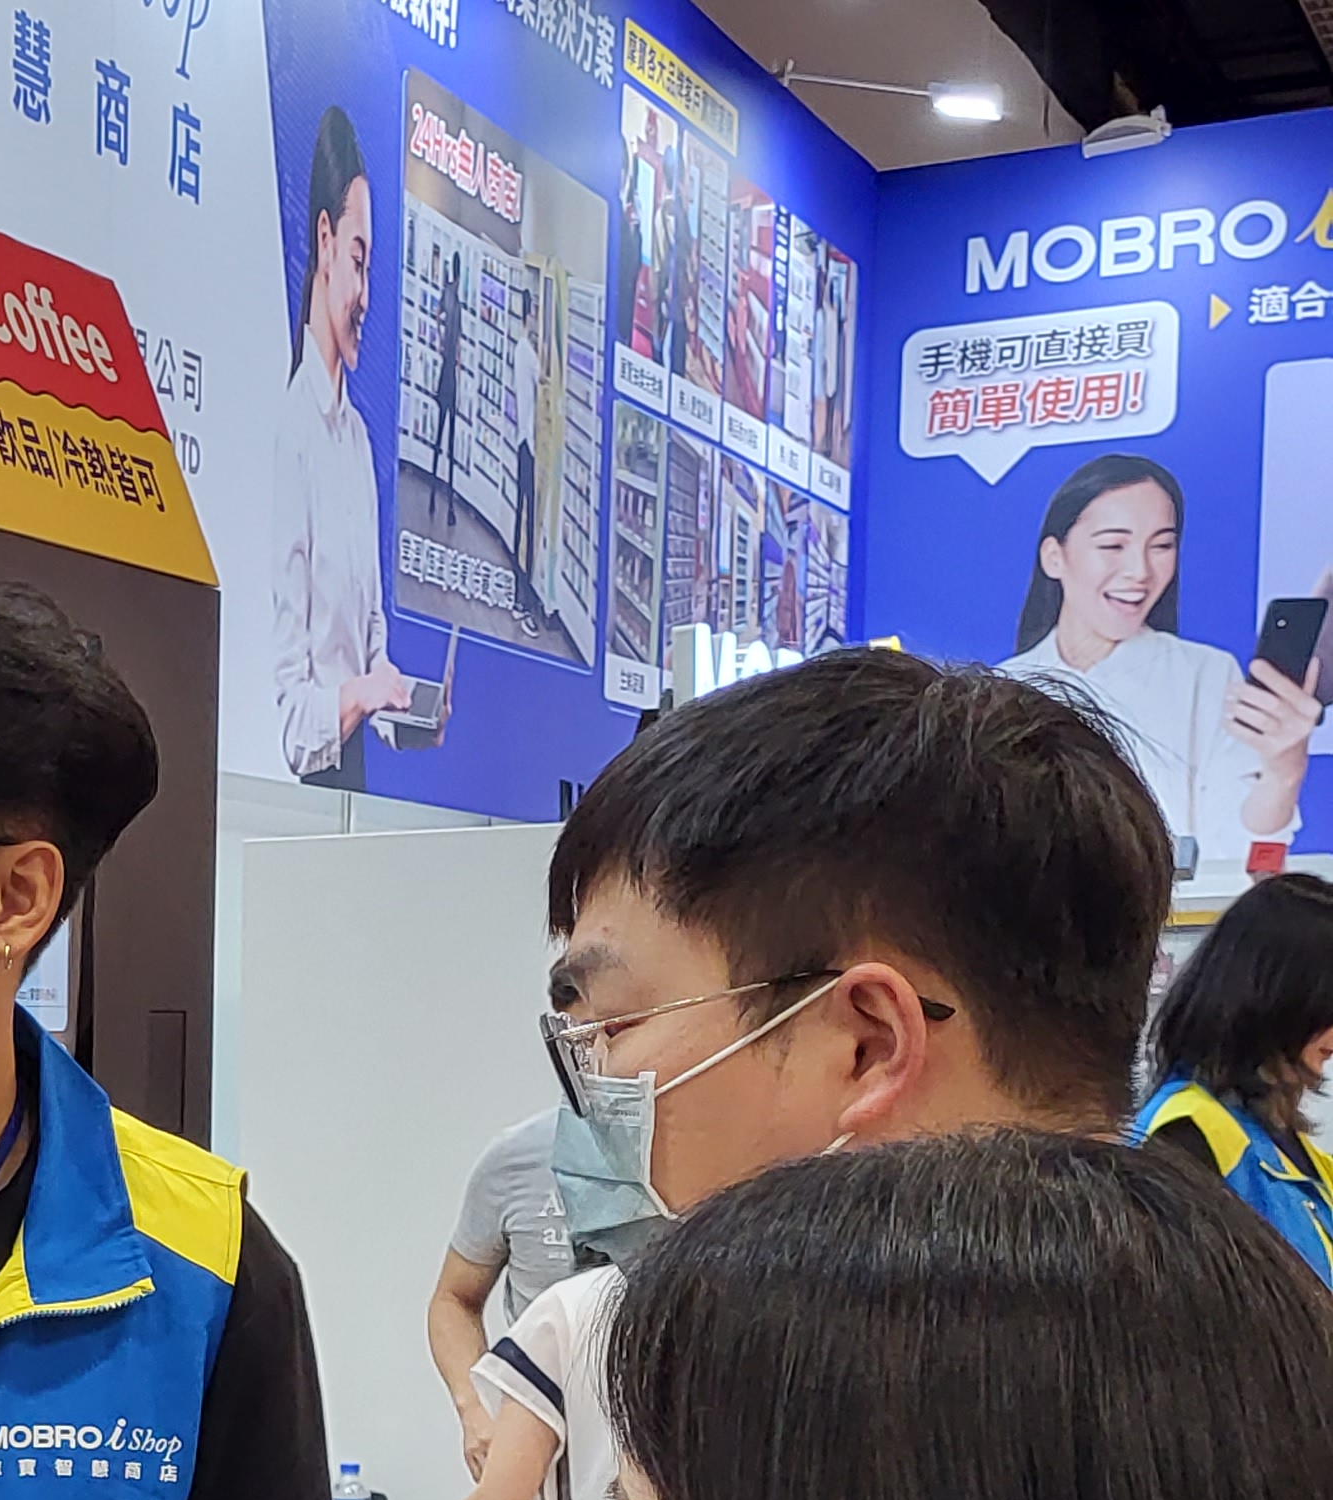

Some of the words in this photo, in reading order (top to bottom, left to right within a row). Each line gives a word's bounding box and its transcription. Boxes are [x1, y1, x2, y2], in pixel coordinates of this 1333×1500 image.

[965, 199, 1288, 293] MOBRO
[918, 320, 1151, 381] 手機可直接買
[926, 371, 1146, 437] 簡單使用!
[104, 1418, 127, 1451] i
[128, 1427, 183, 1462] Shop
